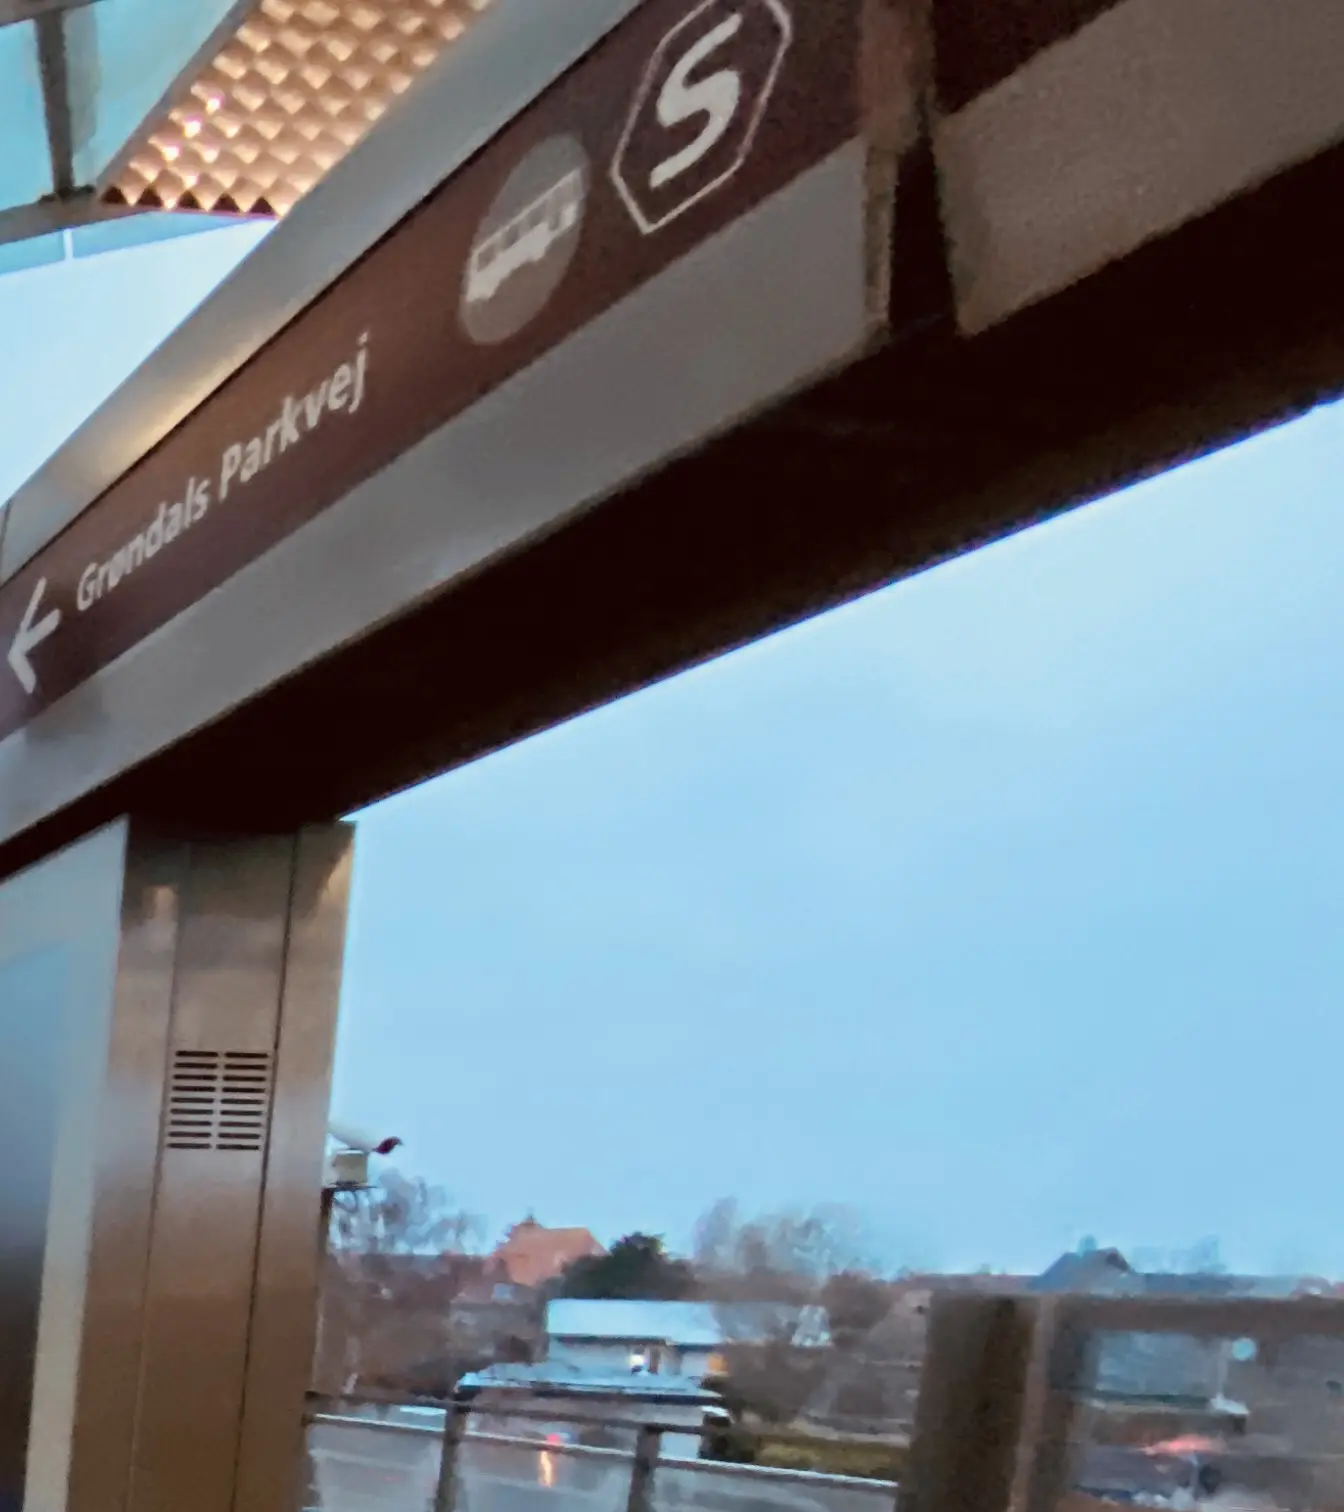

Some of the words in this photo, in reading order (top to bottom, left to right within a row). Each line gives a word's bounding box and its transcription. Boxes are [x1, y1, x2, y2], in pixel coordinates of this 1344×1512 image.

[649, 12, 743, 190] S
[76, 476, 210, 612] Grøndals
[219, 331, 369, 504] Parkvej
